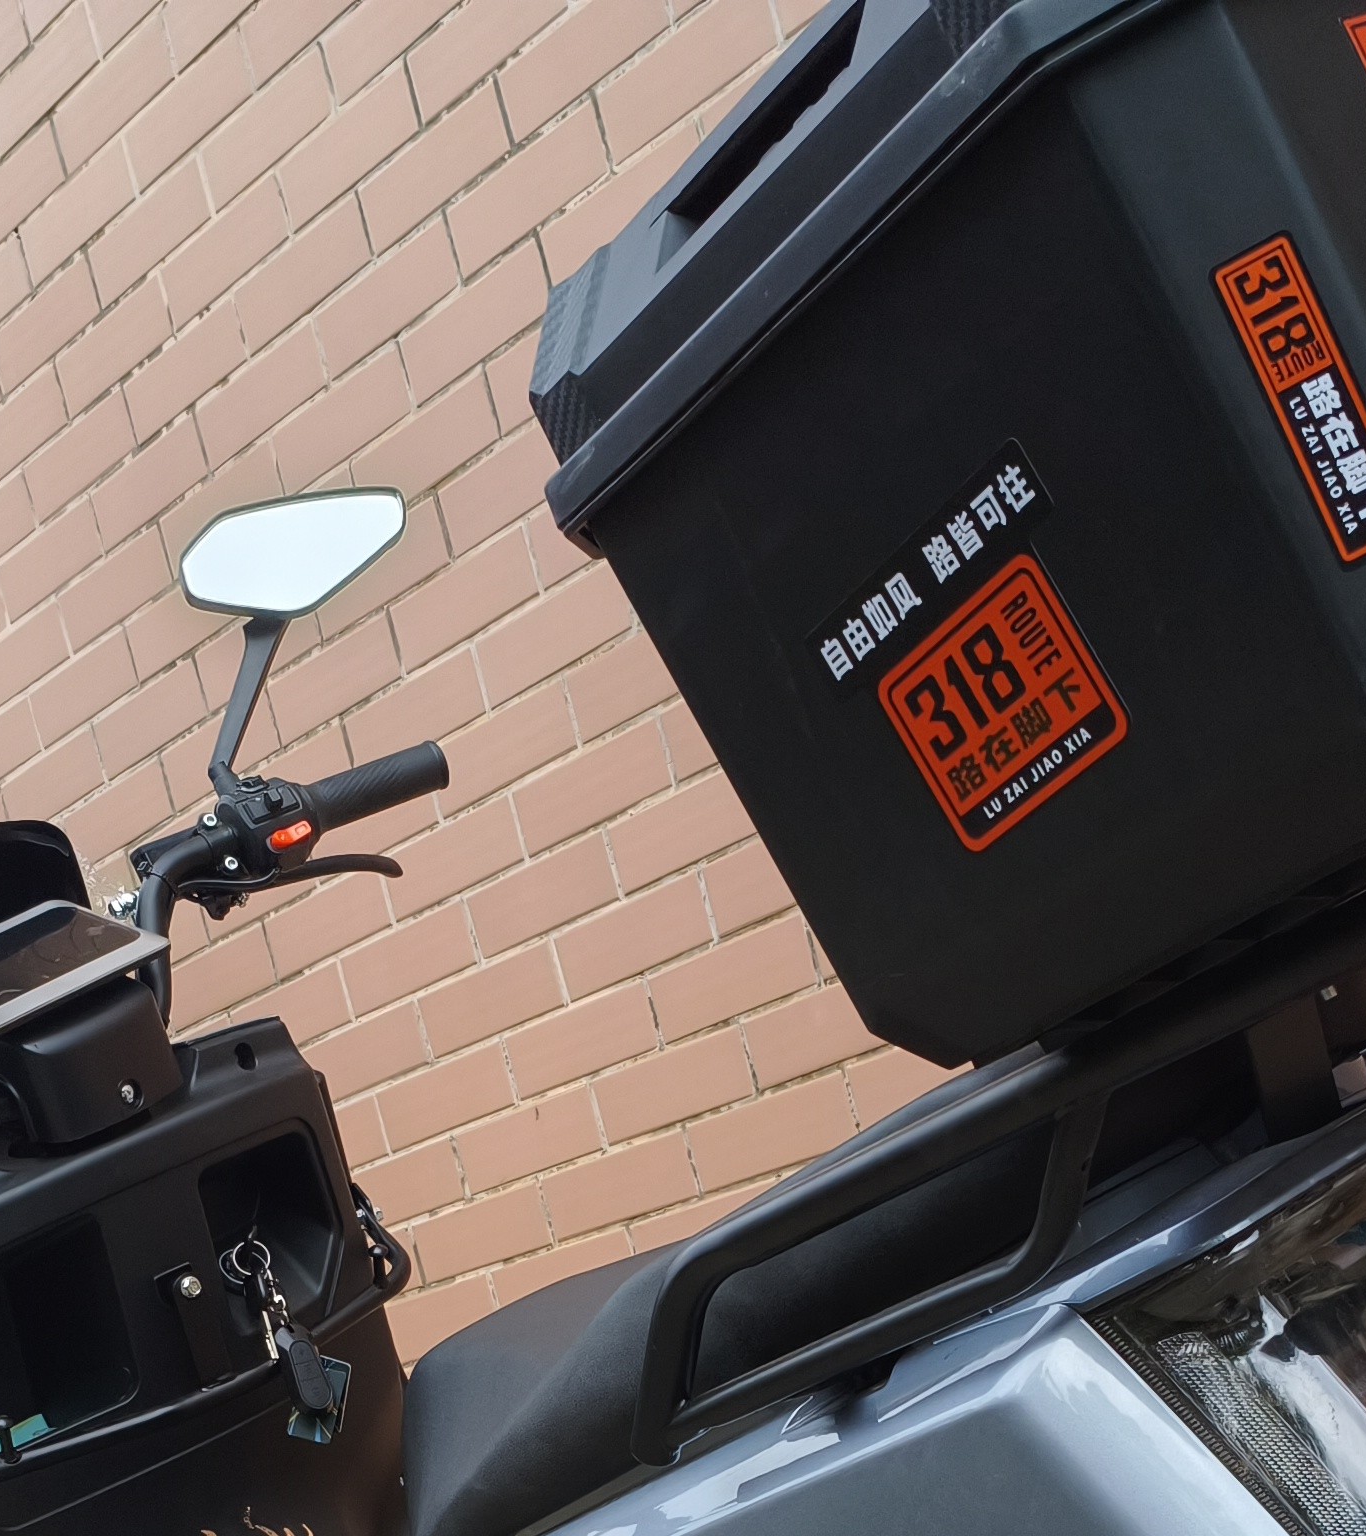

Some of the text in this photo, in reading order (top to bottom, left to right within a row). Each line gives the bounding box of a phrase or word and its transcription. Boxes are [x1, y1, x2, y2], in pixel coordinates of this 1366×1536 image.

[1233, 255, 1316, 363] 318
[1271, 340, 1325, 384] ROUTE
[1289, 396, 1359, 535] LU ZAI JIAO XIA
[1000, 590, 1062, 677] ROUTE
[904, 622, 1027, 762] 318
[946, 667, 1083, 803] 路在脚下
[982, 726, 1092, 819] LU ZAI JIAO XIA
